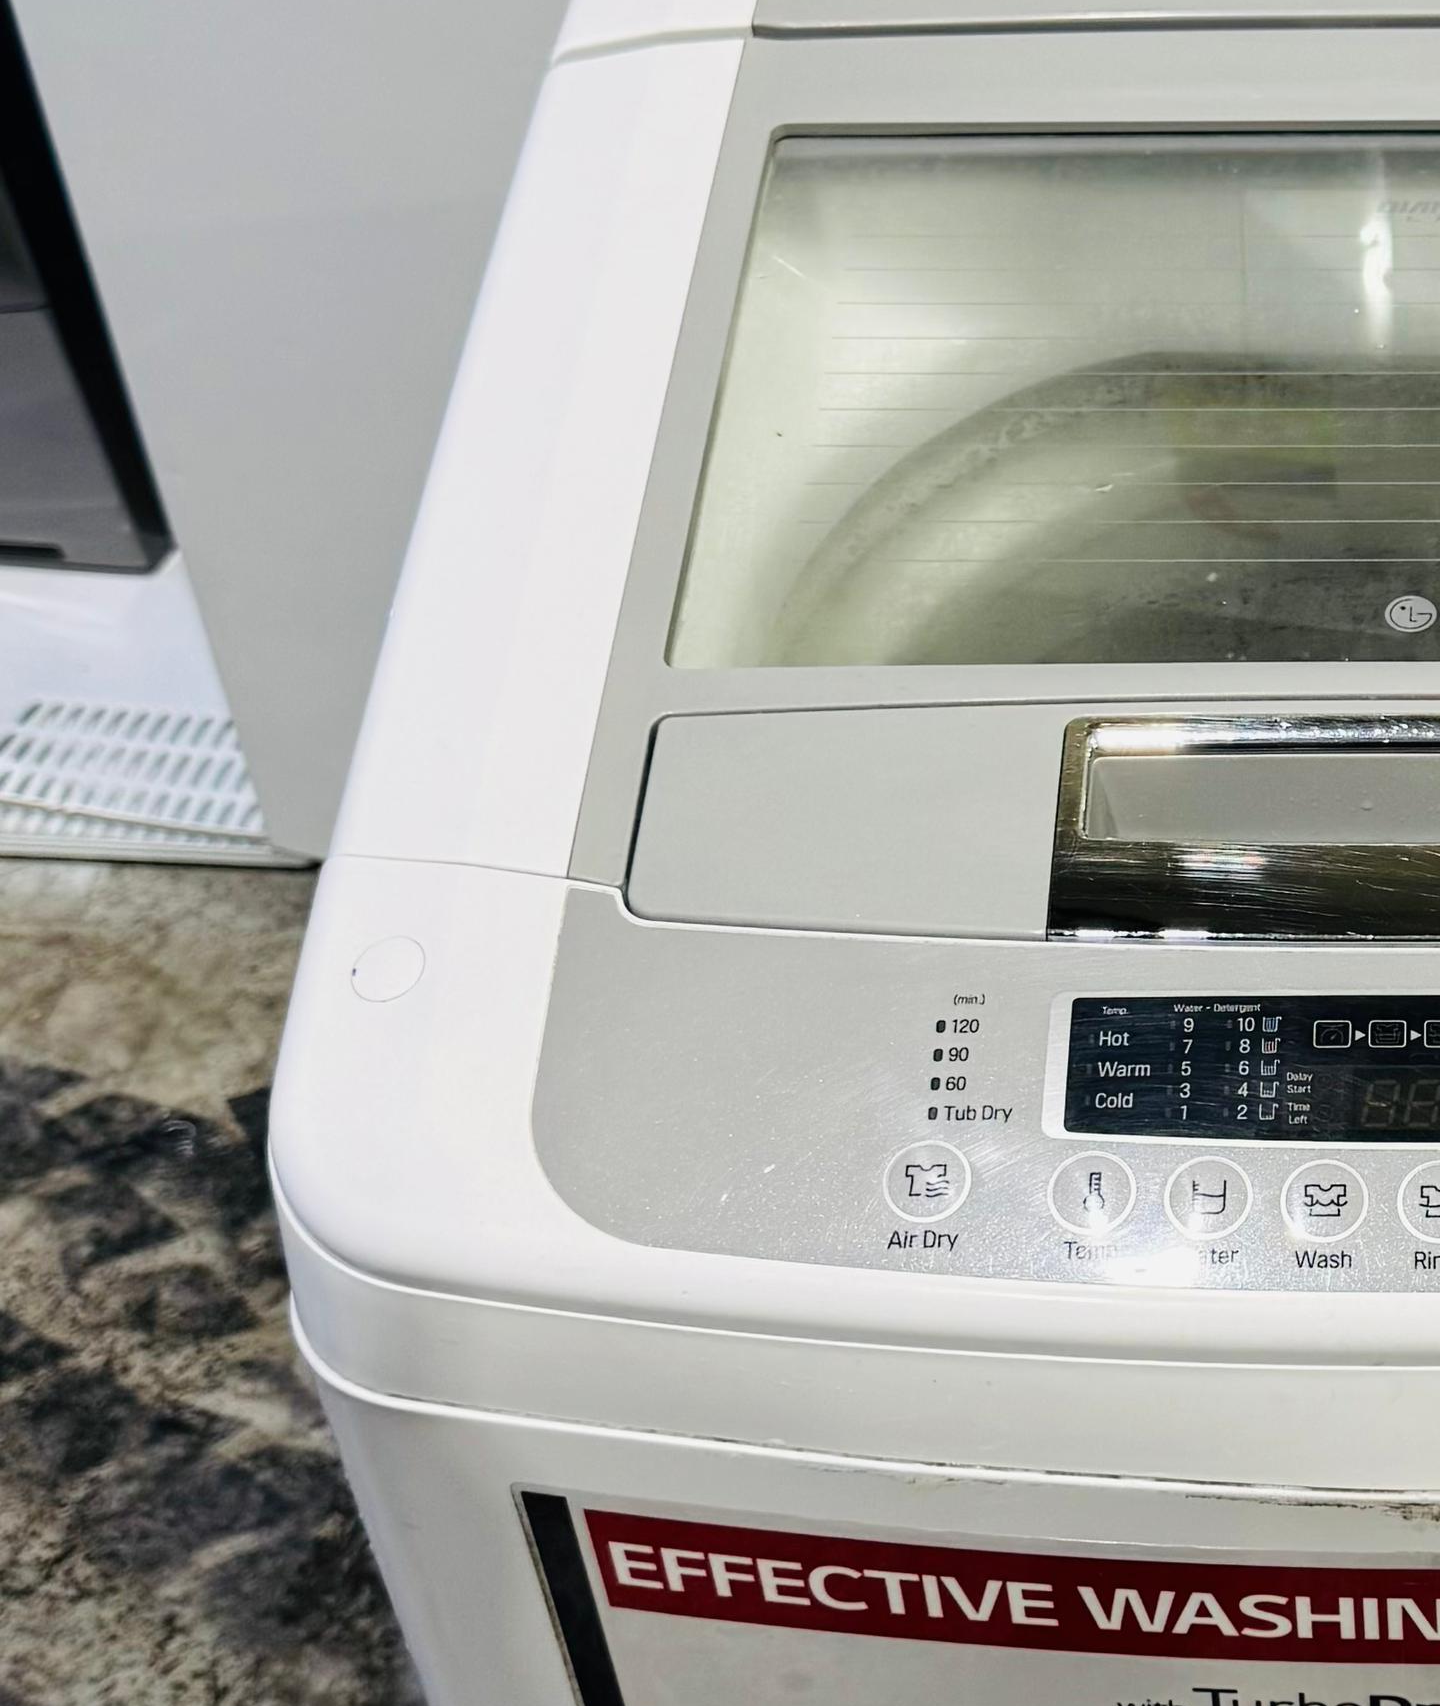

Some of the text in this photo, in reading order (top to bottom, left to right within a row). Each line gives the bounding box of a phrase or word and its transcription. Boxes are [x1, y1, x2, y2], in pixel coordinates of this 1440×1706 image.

[952, 1018, 980, 1034] 120
[1183, 1017, 1195, 1033] 9
[1237, 1017, 1256, 1033] 10
[1099, 1030, 1130, 1047] Hot
[1182, 1039, 1194, 1054] 7
[1238, 1038, 1251, 1054] 8
[948, 1047, 970, 1062] 90
[1097, 1060, 1152, 1078] Warm
[1180, 1060, 1192, 1076] 5
[1238, 1060, 1250, 1076] 6
[945, 1076, 967, 1091] 60
[1179, 1082, 1191, 1099] 3
[1237, 1081, 1249, 1097] 4
[1095, 1092, 1134, 1110] Cold
[943, 1105, 1013, 1123] Tub Dry
[1179, 1105, 1188, 1120] 1
[1236, 1104, 1248, 1120] 2
[887, 1230, 959, 1252] Air Dry
[1294, 1249, 1353, 1269] Wash
[607, 1540, 1060, 1627] EFFECTIVE
